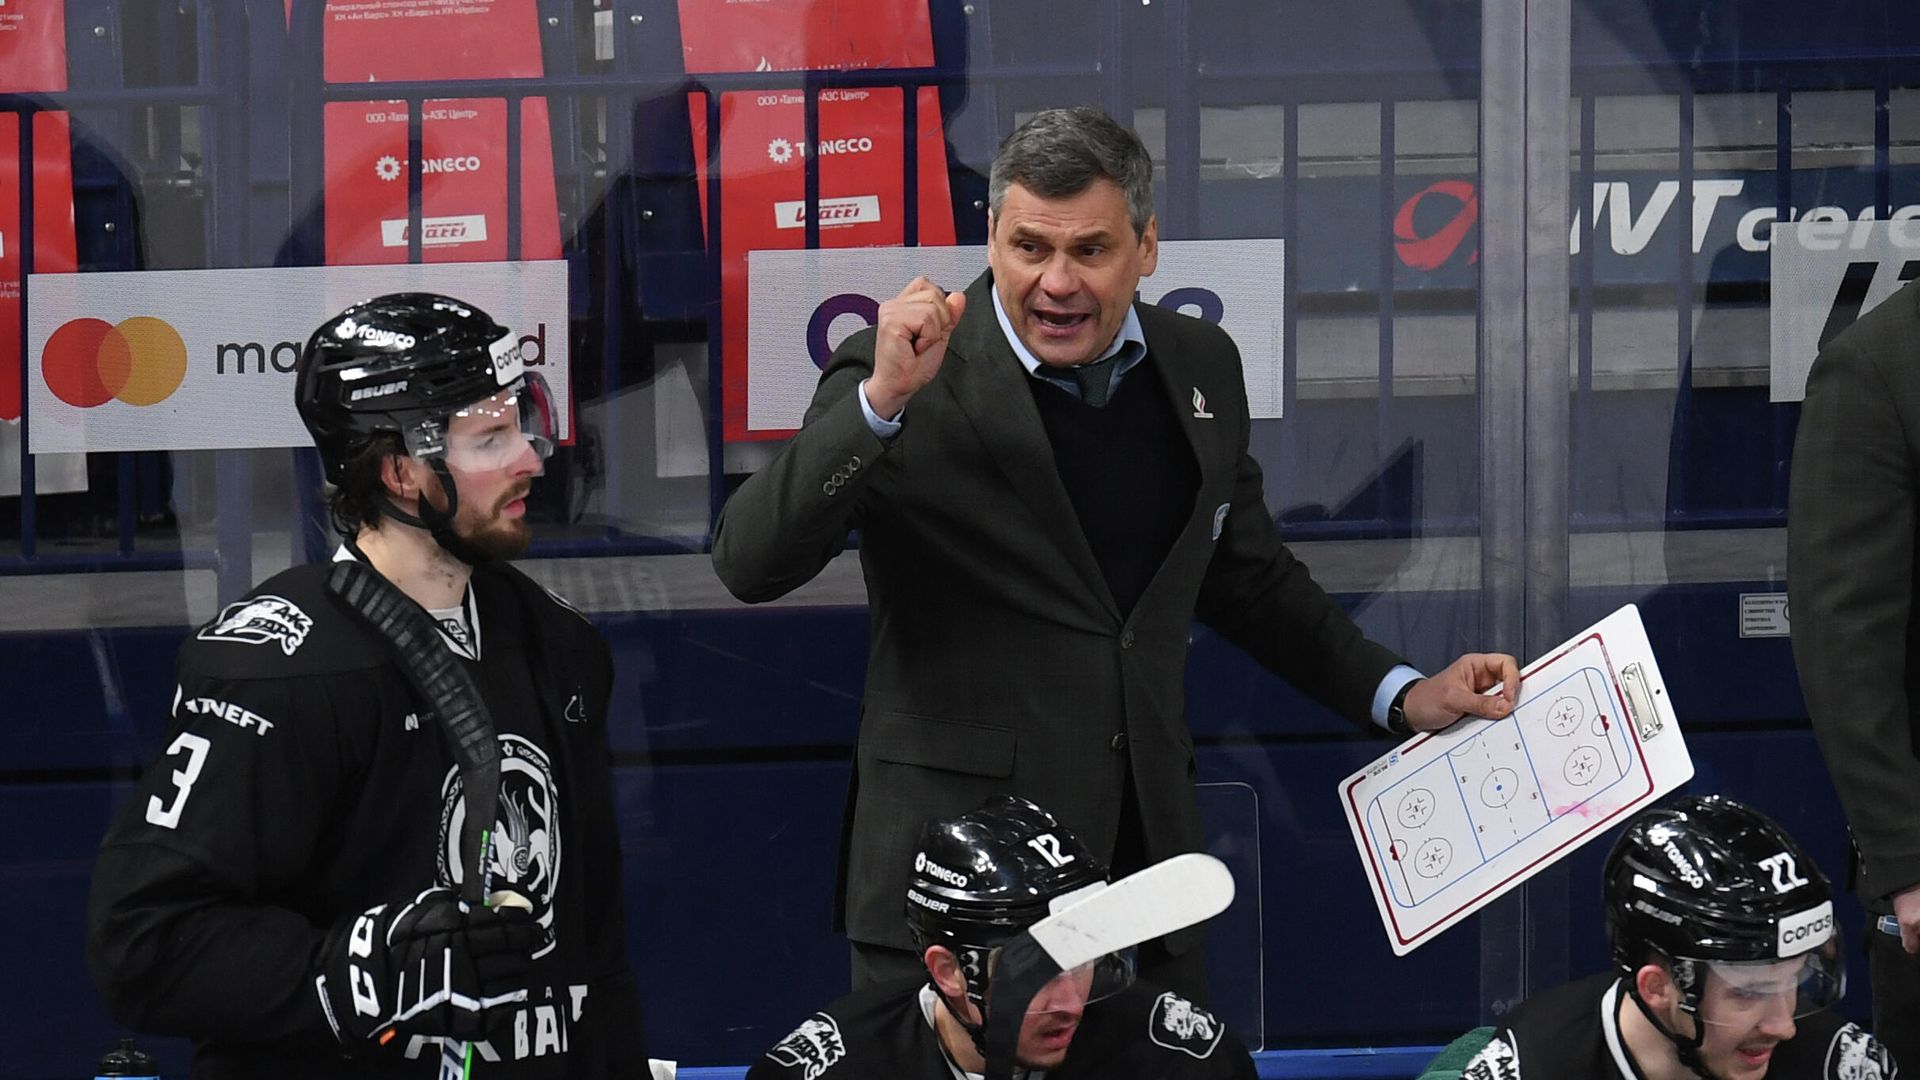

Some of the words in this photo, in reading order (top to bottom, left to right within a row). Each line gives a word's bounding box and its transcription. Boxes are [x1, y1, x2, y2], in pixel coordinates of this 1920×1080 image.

[796, 137, 872, 158] TNECO
[145, 731, 211, 829] 3
[1026, 833, 1075, 868] 12
[1758, 852, 1808, 894] 22
